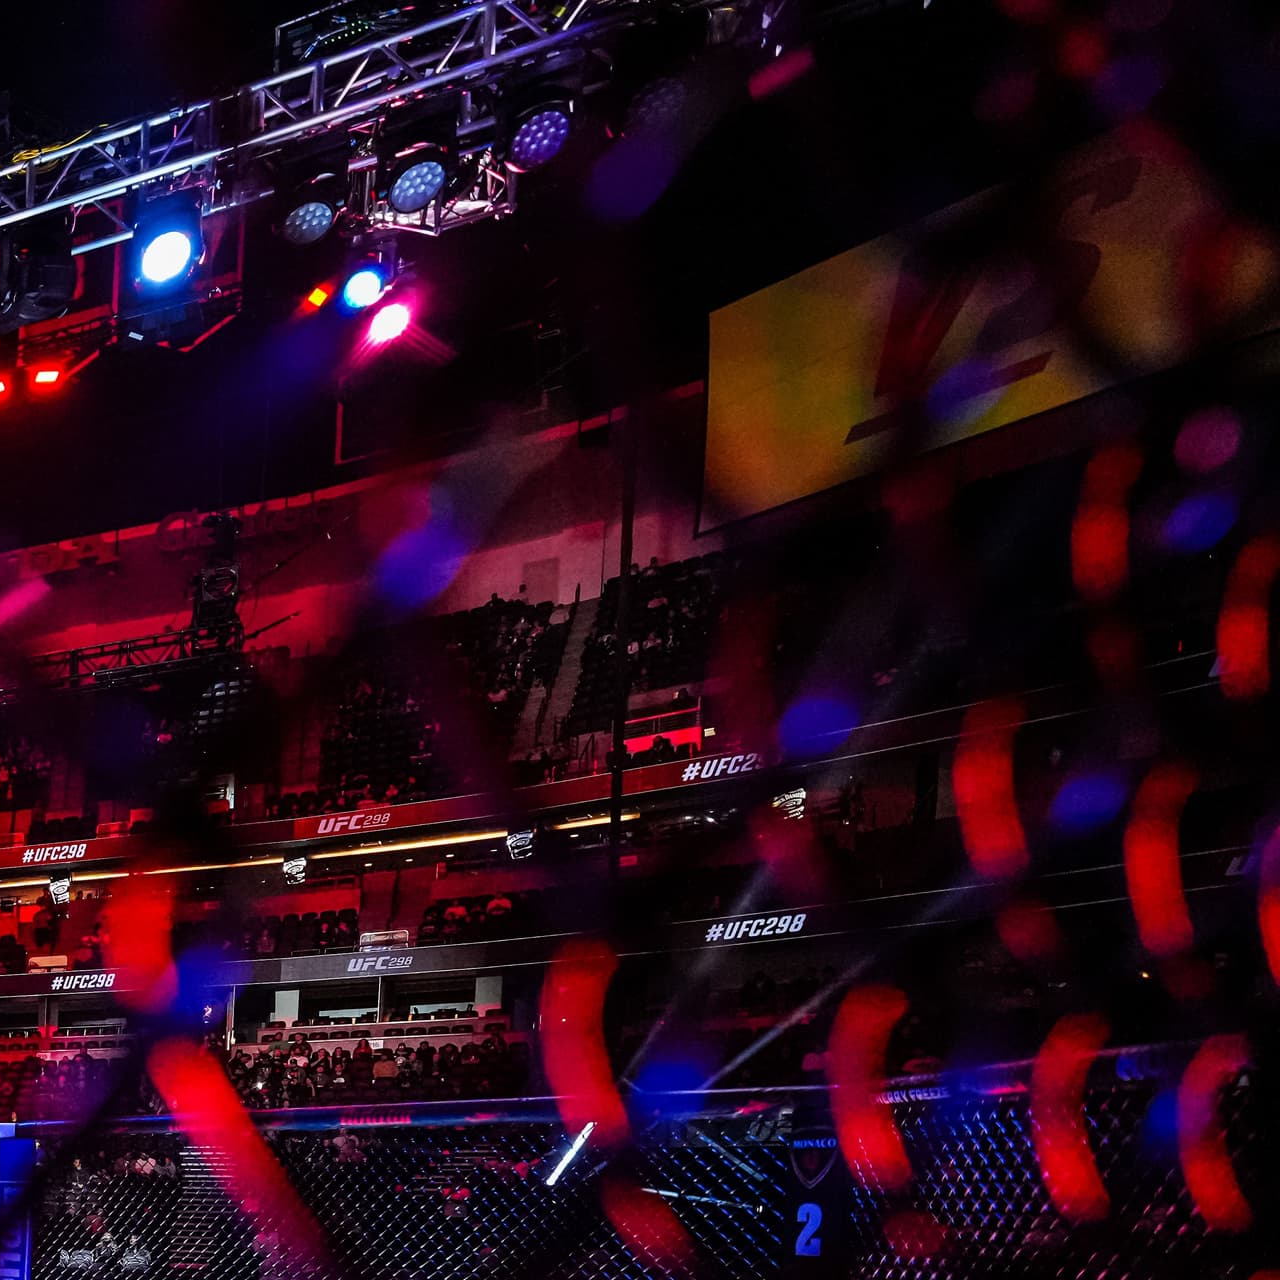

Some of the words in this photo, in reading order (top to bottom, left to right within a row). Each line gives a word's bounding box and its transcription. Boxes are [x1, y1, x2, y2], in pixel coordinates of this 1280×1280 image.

[317, 814, 365, 834] UFC
[22, 844, 87, 864] #UFC298
[705, 913, 807, 943] #UFC298
[347, 956, 391, 972] UFC
[51, 973, 116, 990] #UFC298
[794, 1202, 823, 1257] 2
